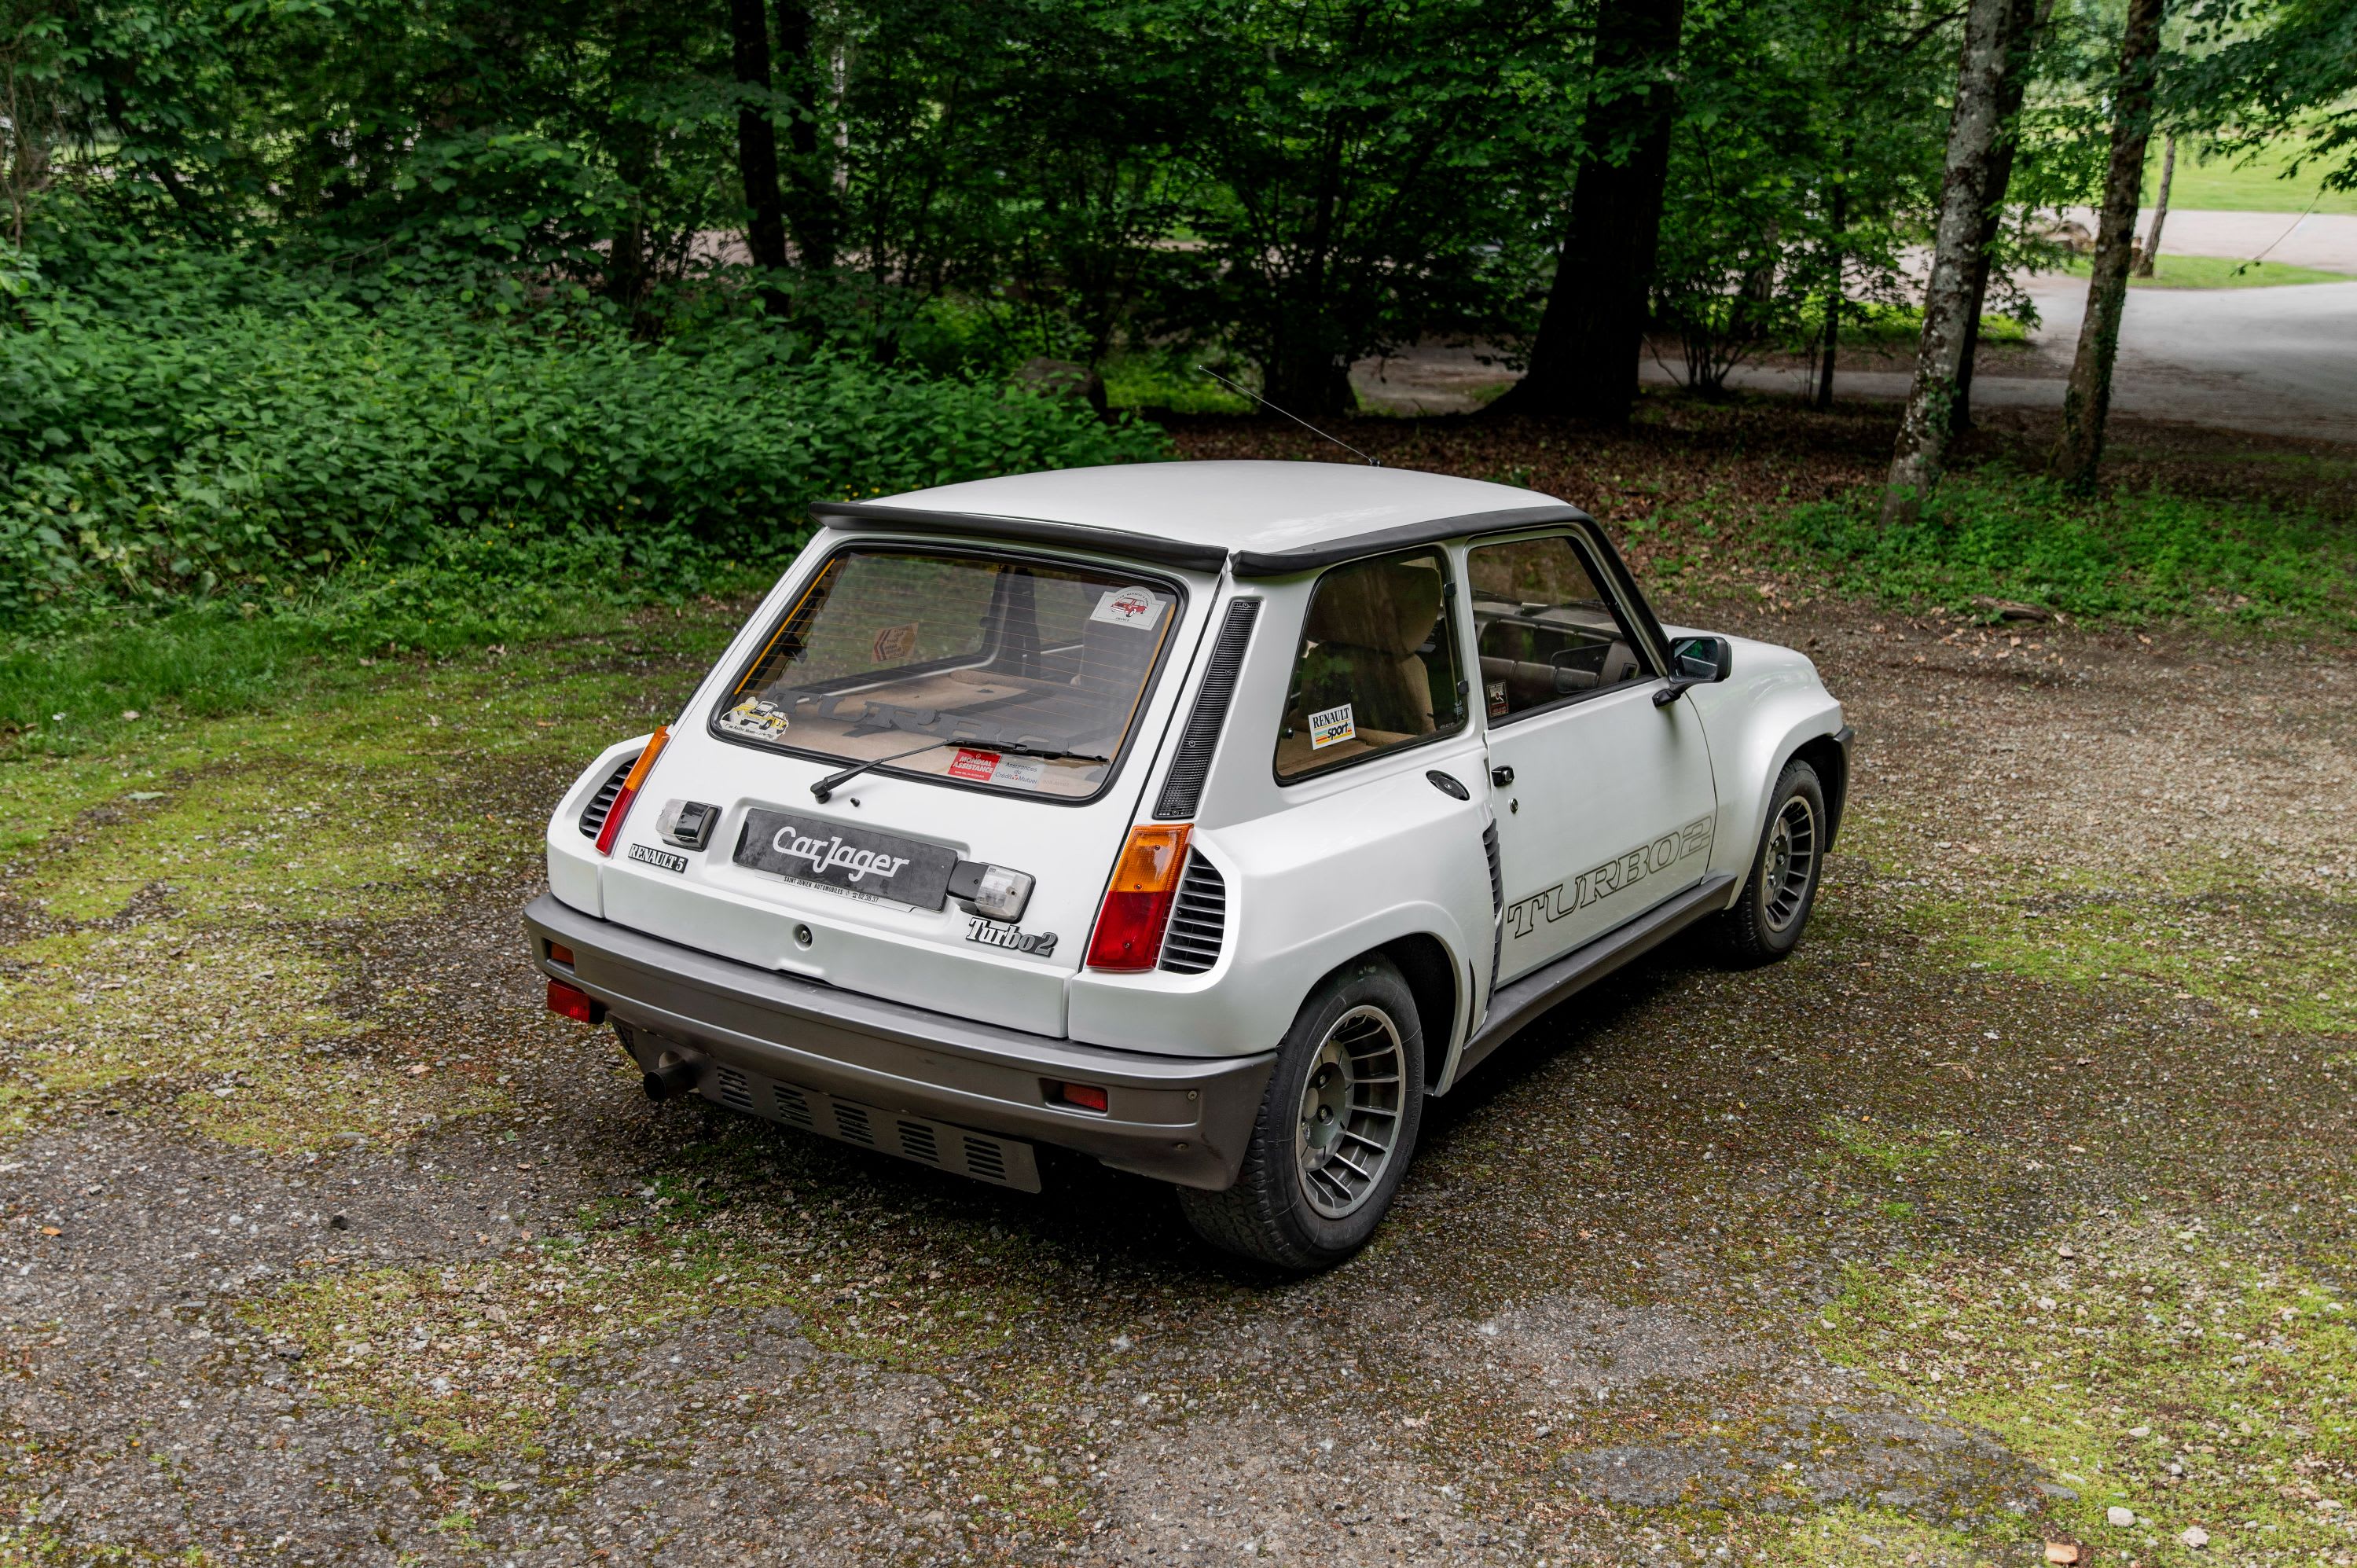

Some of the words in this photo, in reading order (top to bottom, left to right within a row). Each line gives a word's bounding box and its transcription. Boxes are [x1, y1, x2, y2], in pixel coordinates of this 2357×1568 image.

[1313, 707, 1349, 729] RENAULT
[1327, 722, 1348, 740] sport
[953, 761, 994, 773] ASSISTANCE
[960, 756, 992, 767] MONDIAL
[1005, 762, 1037, 772] Assurances
[995, 771, 1012, 780] Crédit
[1018, 776, 1037, 784] Mutuel
[629, 844, 677, 868] RENAULT
[676, 857, 685, 872] 5
[773, 826, 910, 882] CarJager
[813, 883, 843, 894] AUTOMOBILES
